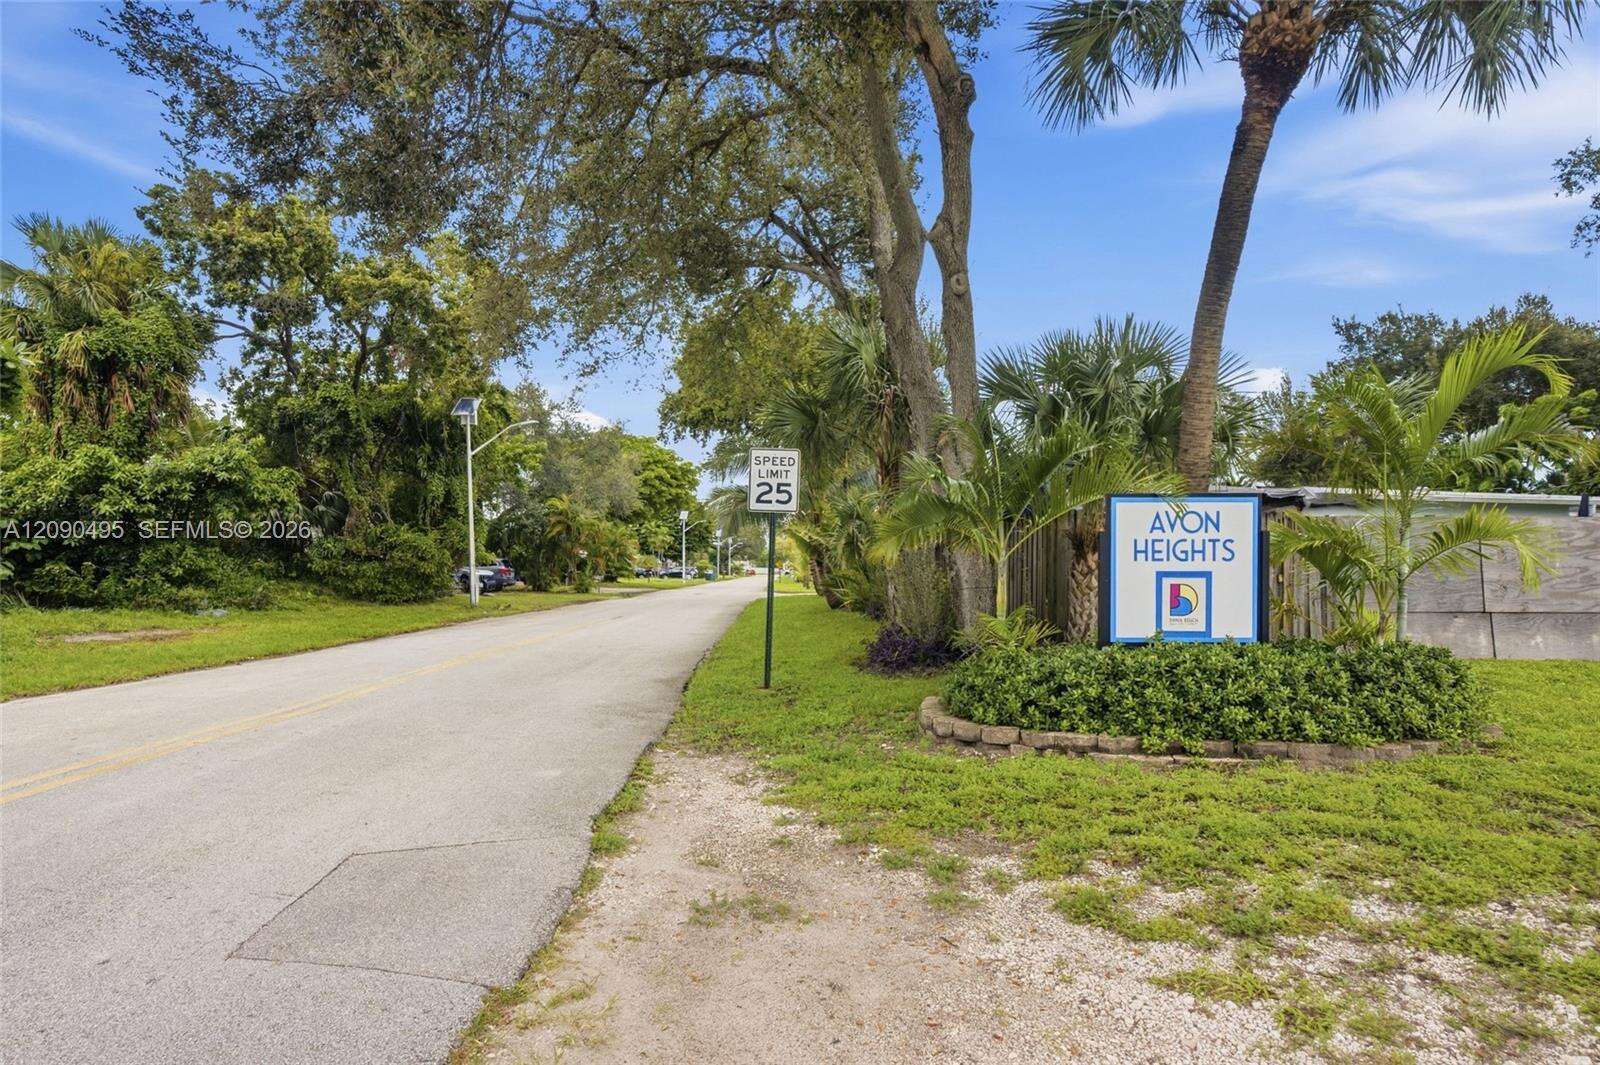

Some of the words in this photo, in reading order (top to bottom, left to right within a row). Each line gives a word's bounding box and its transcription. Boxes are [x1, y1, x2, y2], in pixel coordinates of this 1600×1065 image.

[754, 456, 796, 467] SPEED
[758, 469, 791, 479] LIMIT
[755, 481, 793, 505] 25
[1150, 510, 1221, 534] AVON
[1133, 539, 1235, 562] HEIGHTS
